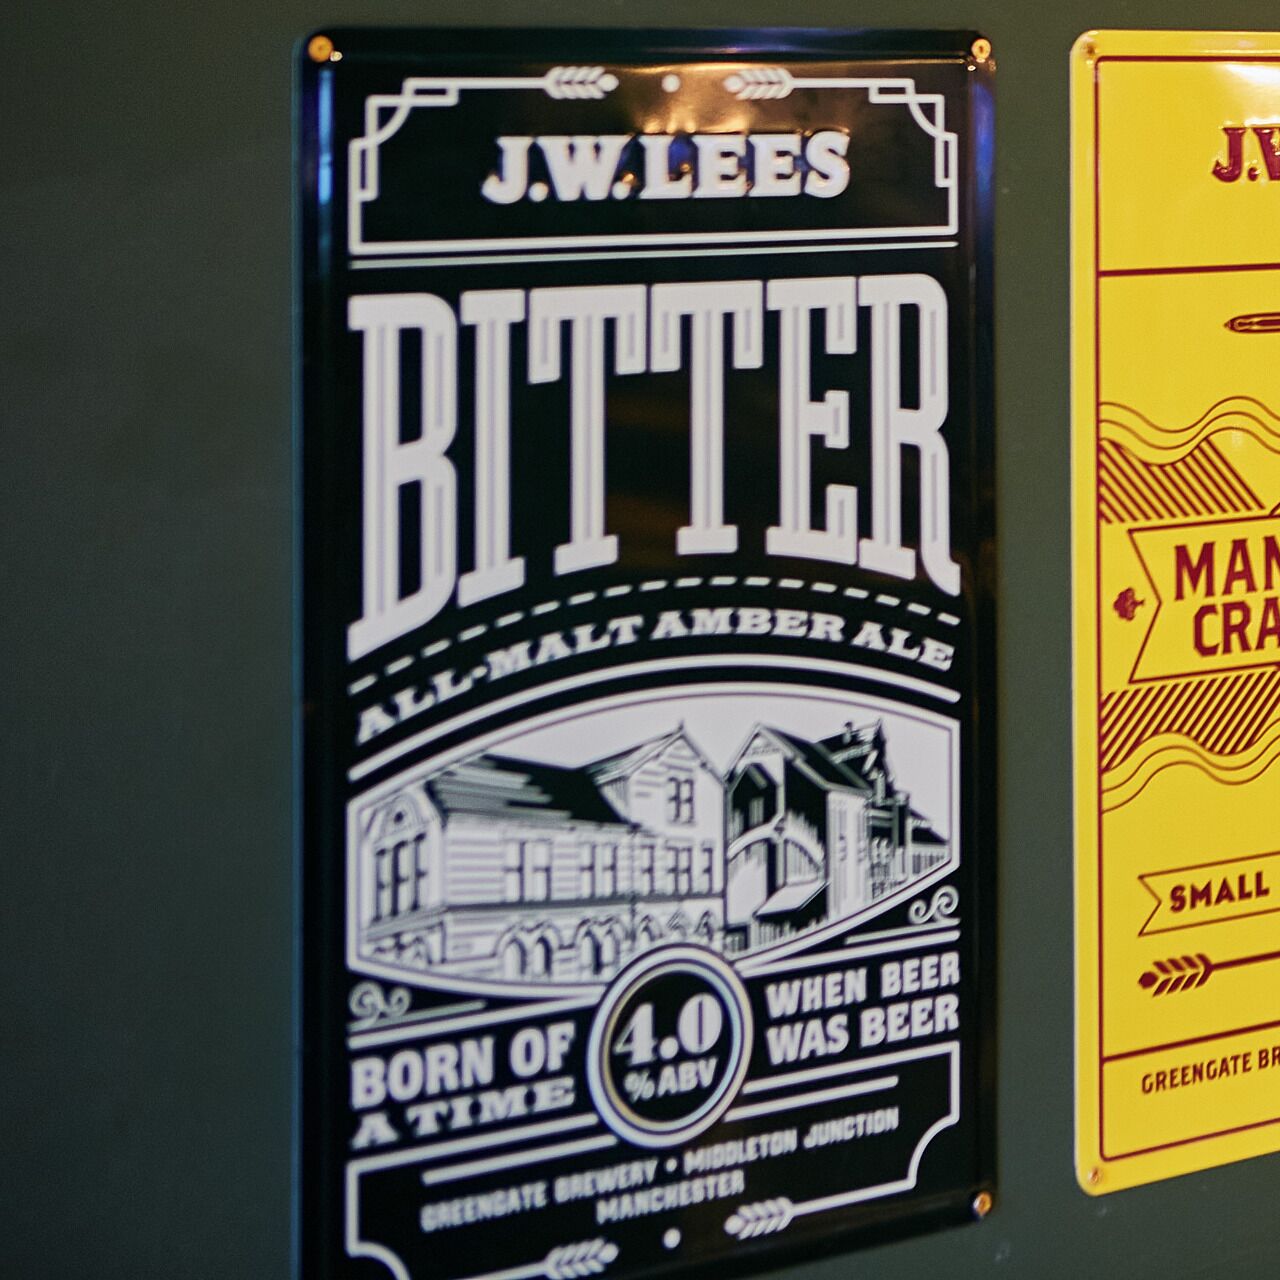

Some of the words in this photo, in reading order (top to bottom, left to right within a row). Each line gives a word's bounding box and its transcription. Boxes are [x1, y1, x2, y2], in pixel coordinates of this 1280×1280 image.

[481, 130, 851, 204] J.W.LEES
[347, 273, 961, 662] BITTER
[356, 613, 644, 745] ALL-MALT
[652, 608, 843, 640] AMBER
[852, 623, 956, 672] ALE
[1170, 871, 1271, 914] SMALL
[766, 966, 867, 1020] WHEN
[880, 951, 960, 999] BEER
[351, 1036, 495, 1109] BORN
[510, 1021, 576, 1075] OF
[614, 993, 723, 1066] 4.0
[766, 1017, 850, 1066] WAS
[859, 996, 960, 1044] BEER
[1141, 1054, 1252, 1095] GREENGATE
[351, 1112, 398, 1150] A
[405, 1076, 576, 1135] TIME
[420, 1182, 548, 1231] GREENGATE
[553, 1158, 657, 1204] BREWERY
[684, 1121, 797, 1173] MIDDLETON
[803, 1107, 900, 1150] JUNCTION
[596, 1171, 745, 1223] MANCHESTER
